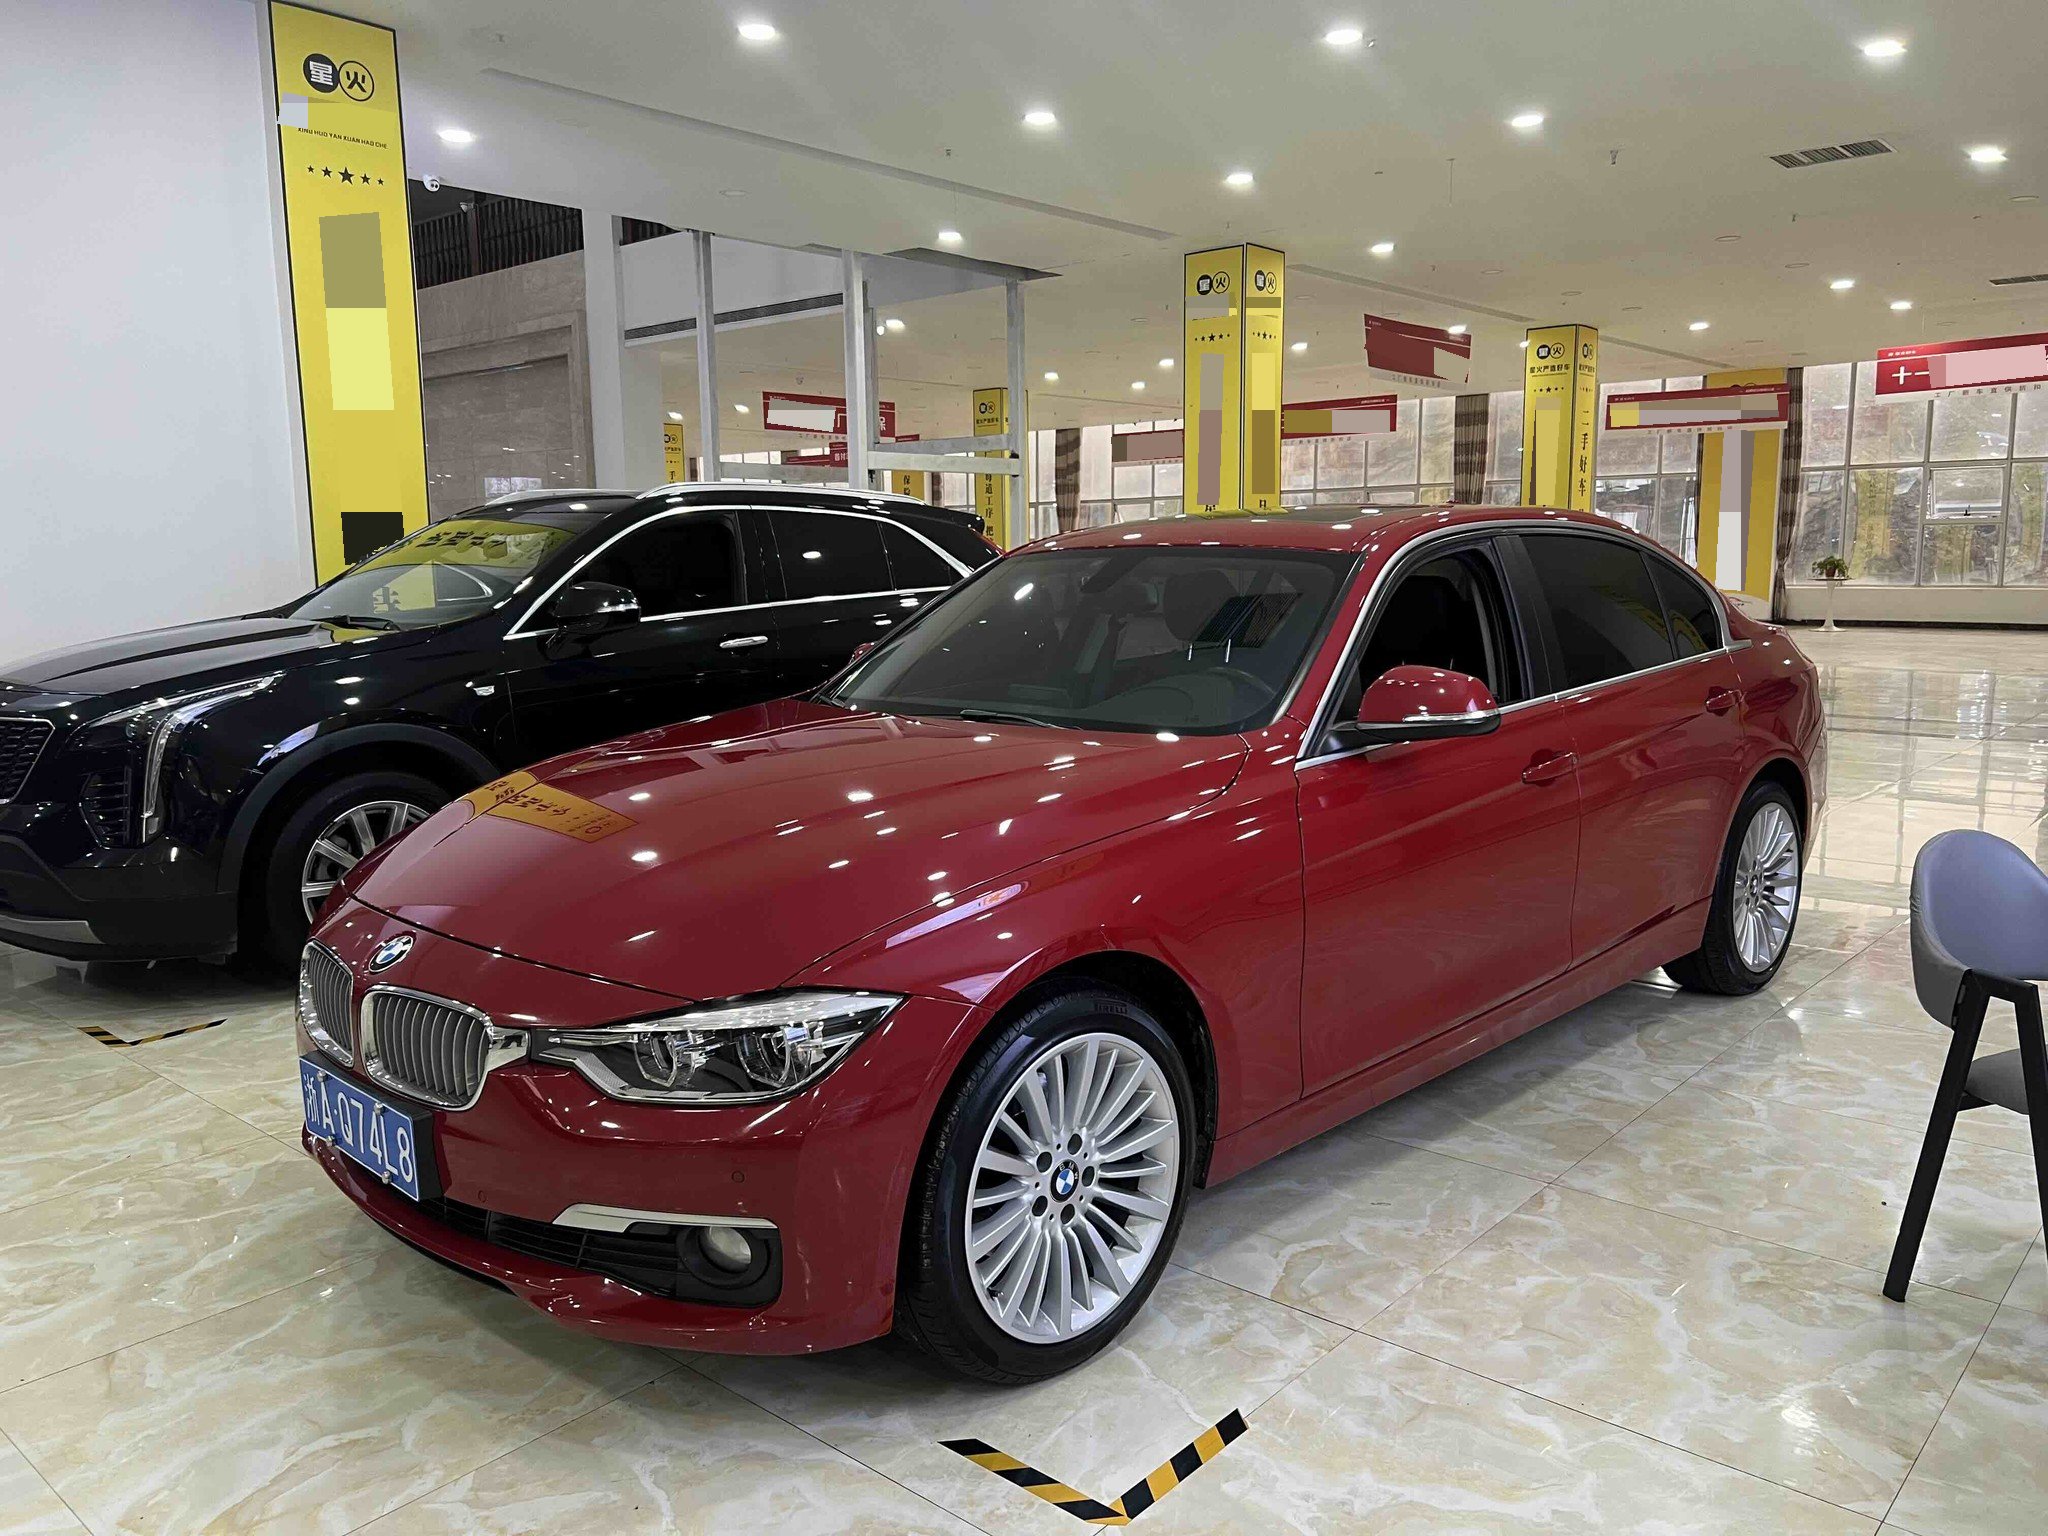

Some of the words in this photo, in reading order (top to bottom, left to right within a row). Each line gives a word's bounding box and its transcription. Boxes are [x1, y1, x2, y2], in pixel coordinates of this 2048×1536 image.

[308, 60, 367, 94] 星火
[329, 132, 343, 140] YAN
[343, 135, 361, 144] XUAN
